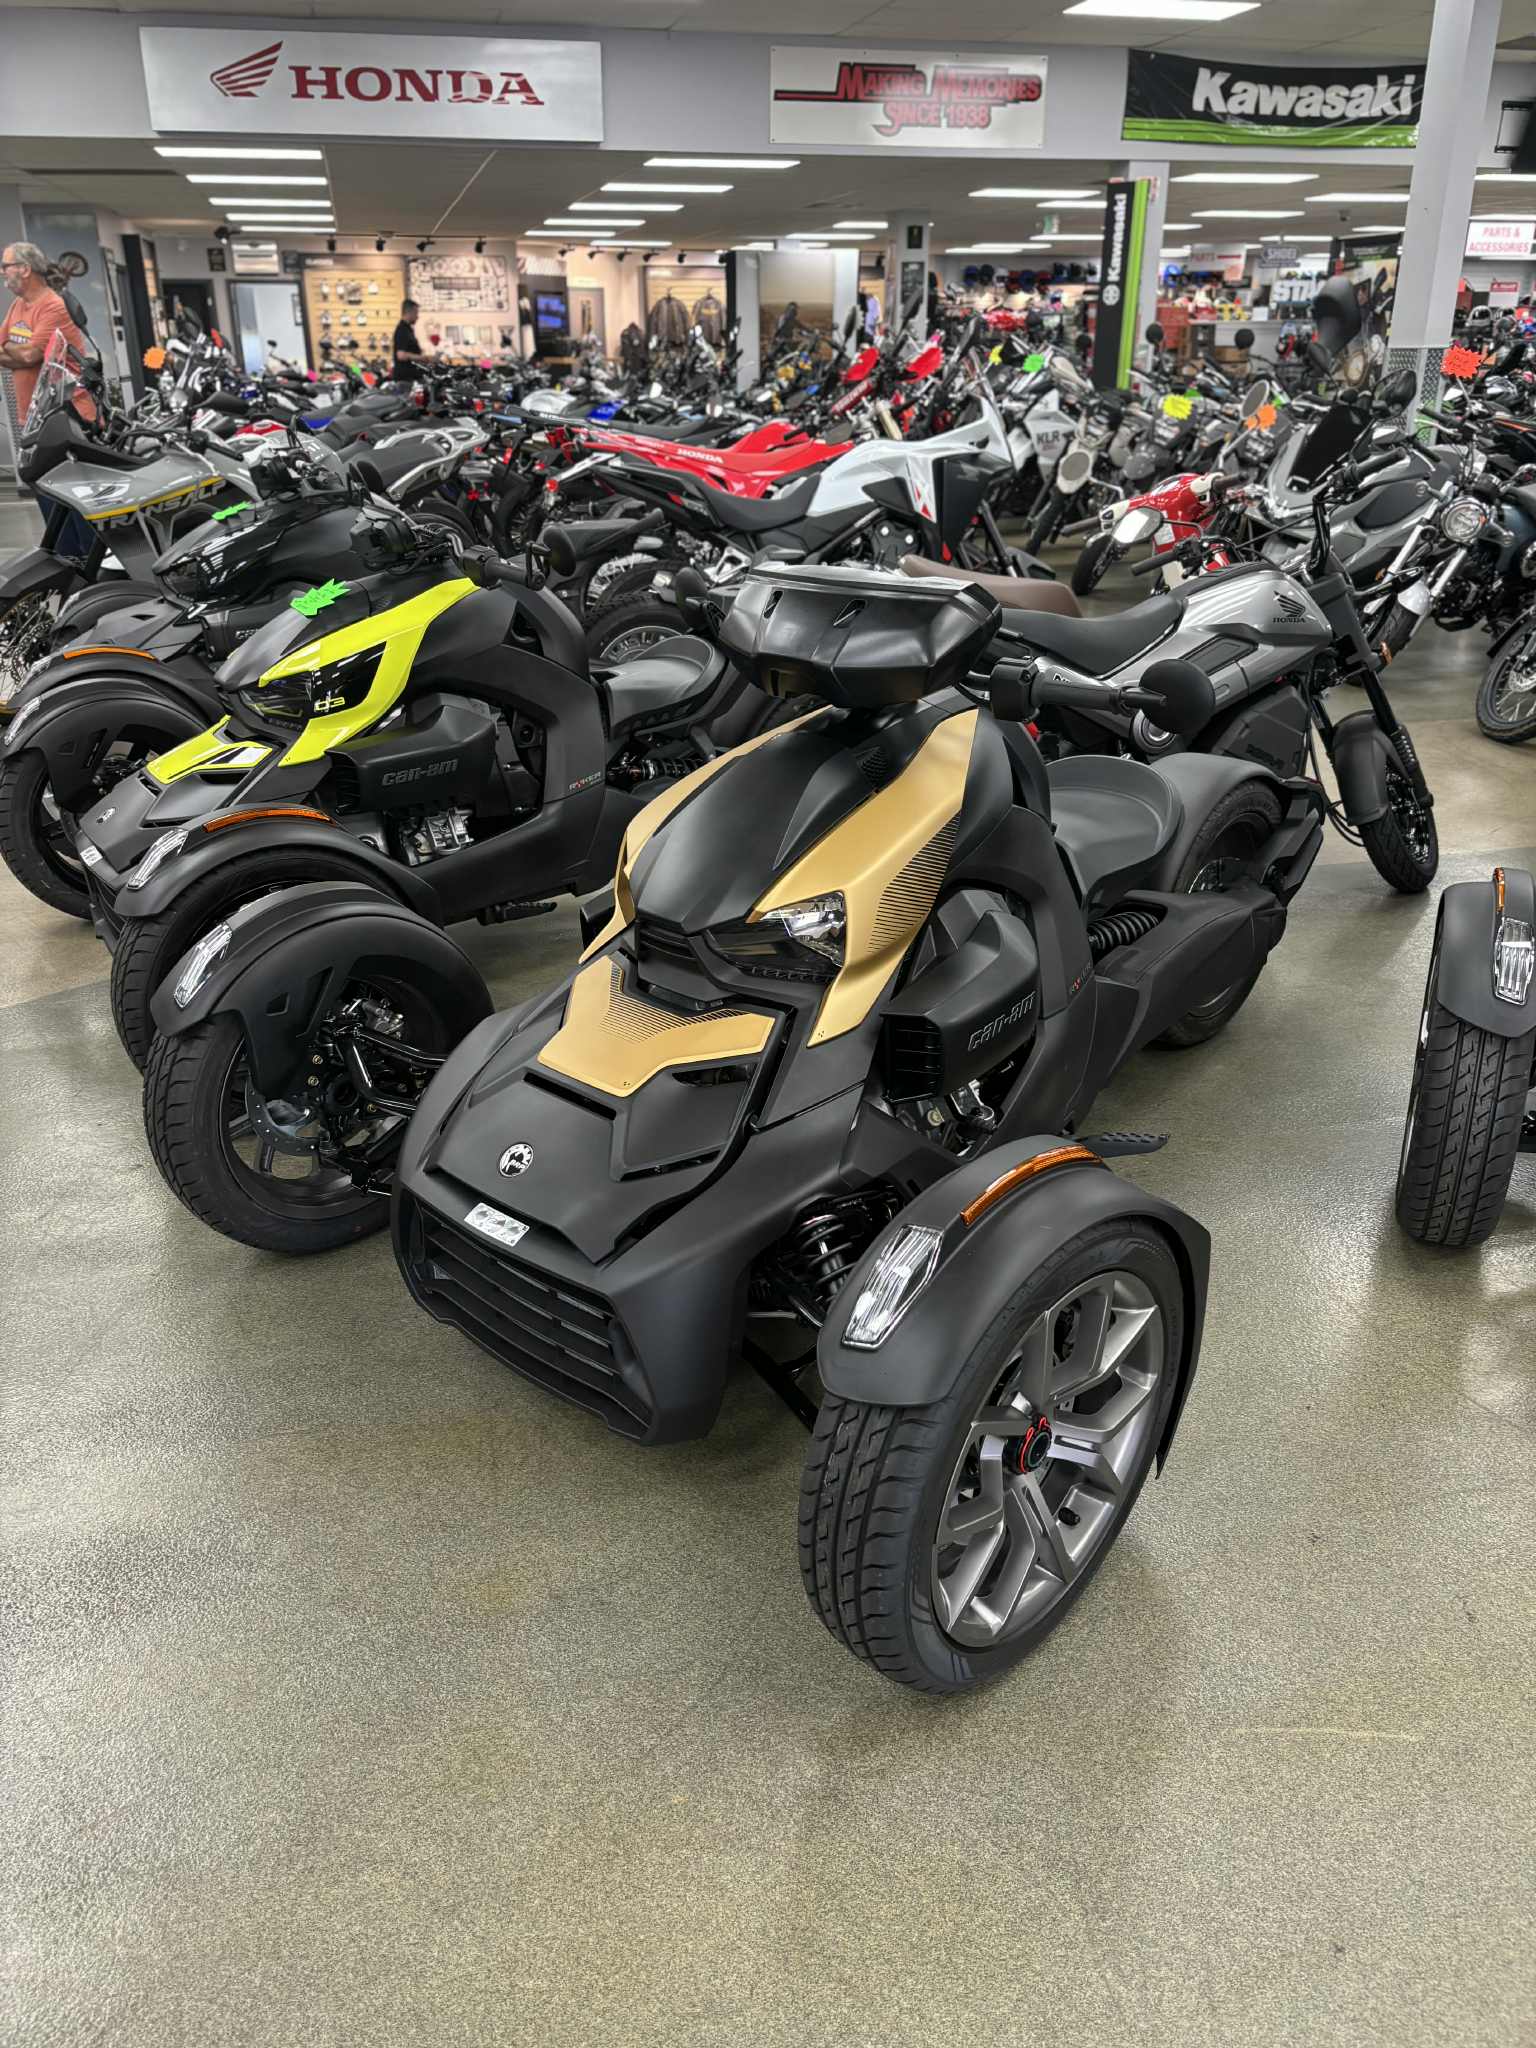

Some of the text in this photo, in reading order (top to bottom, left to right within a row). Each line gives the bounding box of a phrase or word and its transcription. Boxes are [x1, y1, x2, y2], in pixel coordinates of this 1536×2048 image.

[288, 64, 545, 106] HONDA
[1192, 67, 1416, 119] Kawasaki
[871, 102, 941, 136] SINCE
[1107, 193, 1127, 282] Kawasaki
[1468, 241, 1530, 253] ACCESSORIES
[1482, 226, 1512, 238] PARTS
[1036, 430, 1061, 446] KLR
[676, 447, 724, 465] HONDA
[92, 479, 227, 532] TRANSALP
[1272, 616, 1306, 624] HONDA
[382, 758, 459, 786] can-am
[967, 991, 1036, 1052] can-am
